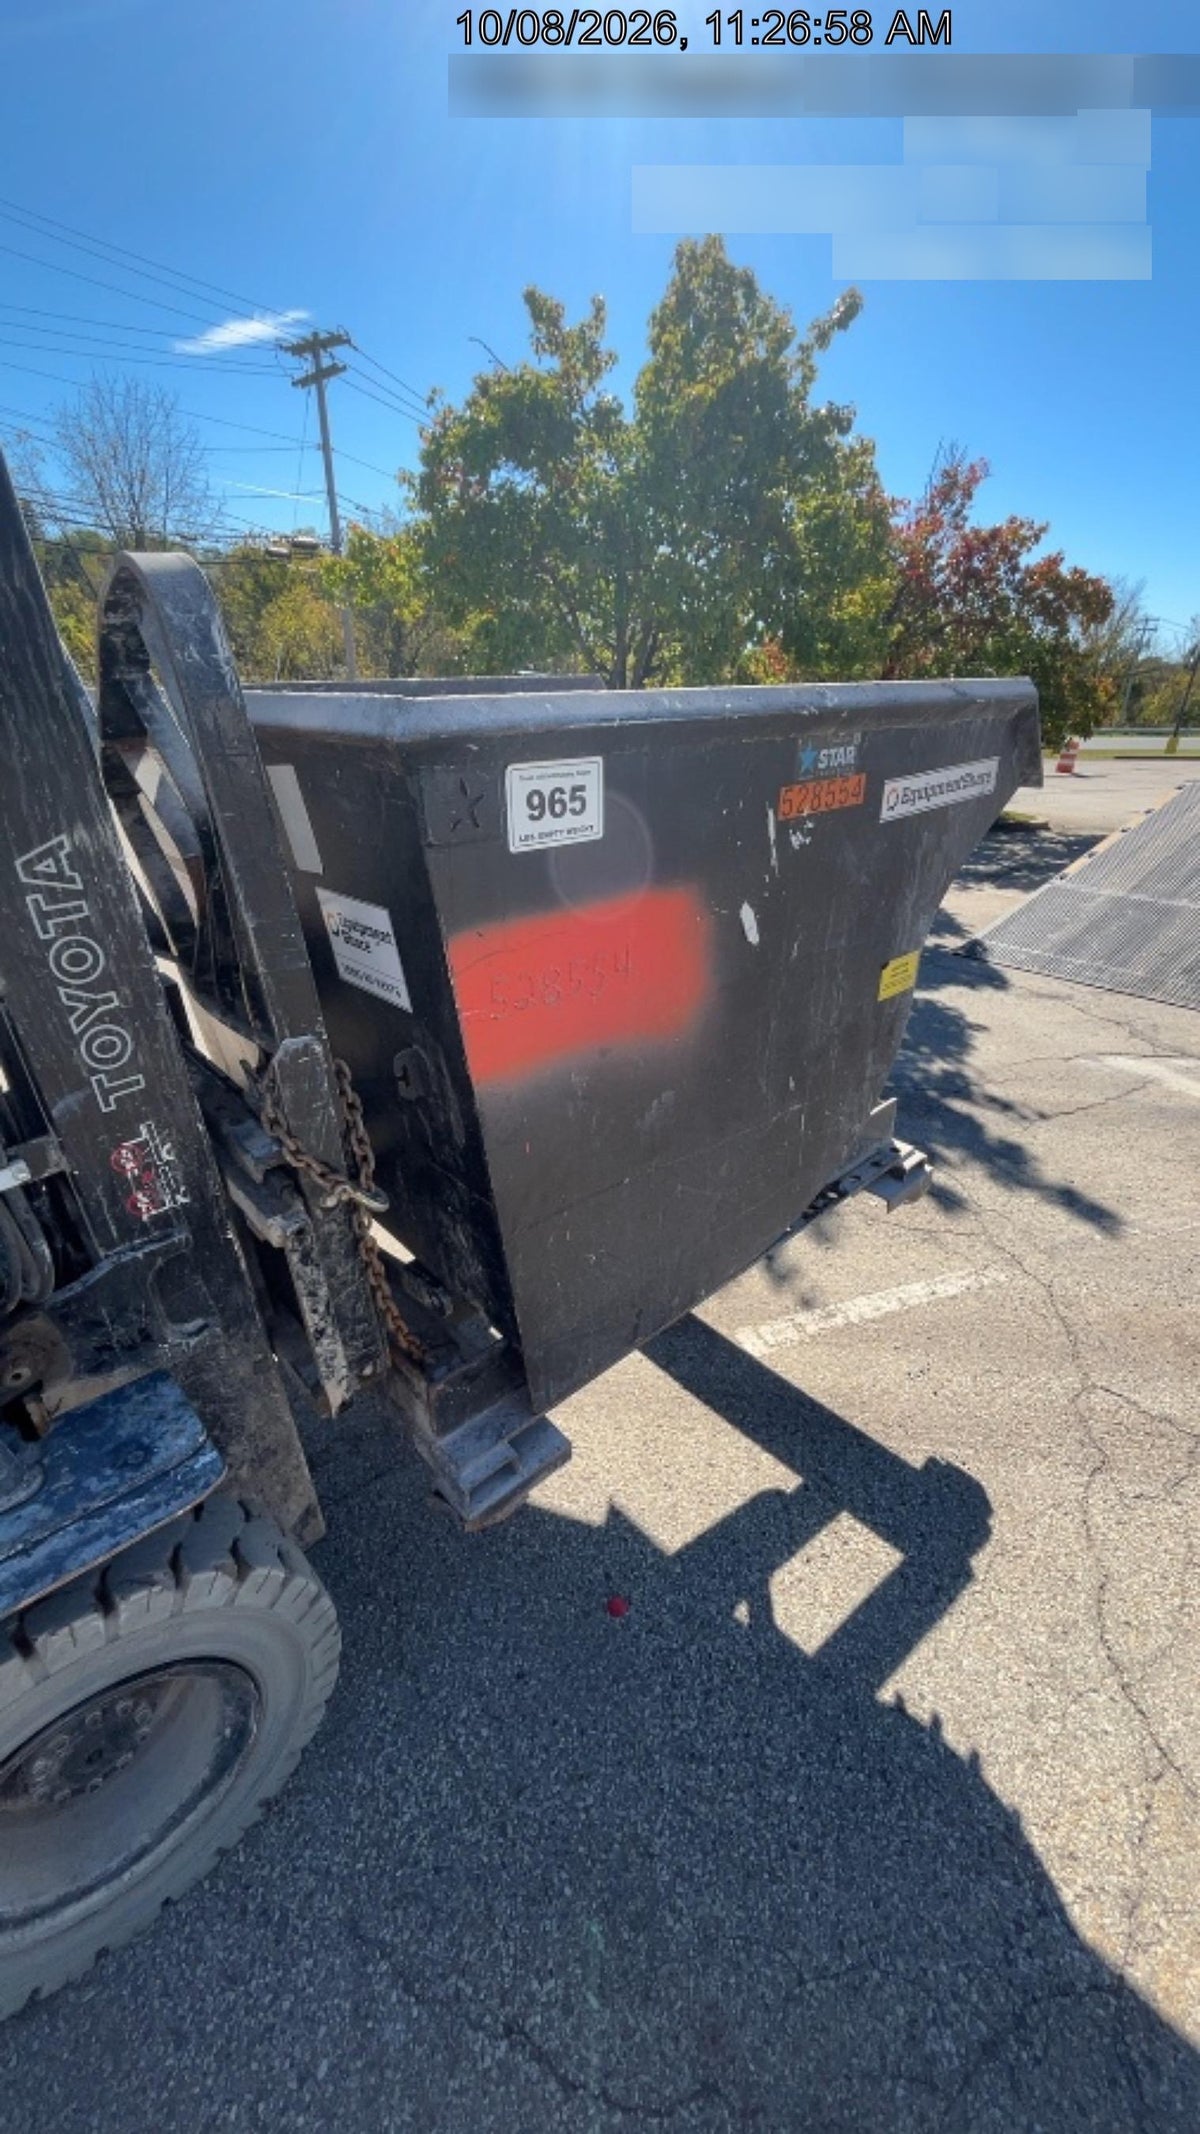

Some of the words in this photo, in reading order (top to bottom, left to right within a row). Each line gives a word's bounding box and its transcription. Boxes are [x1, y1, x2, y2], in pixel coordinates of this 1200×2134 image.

[817, 746, 856, 769] STAR
[525, 784, 587, 821] 965
[782, 777, 863, 817] 528554
[14, 833, 146, 1114] TOYOTA
